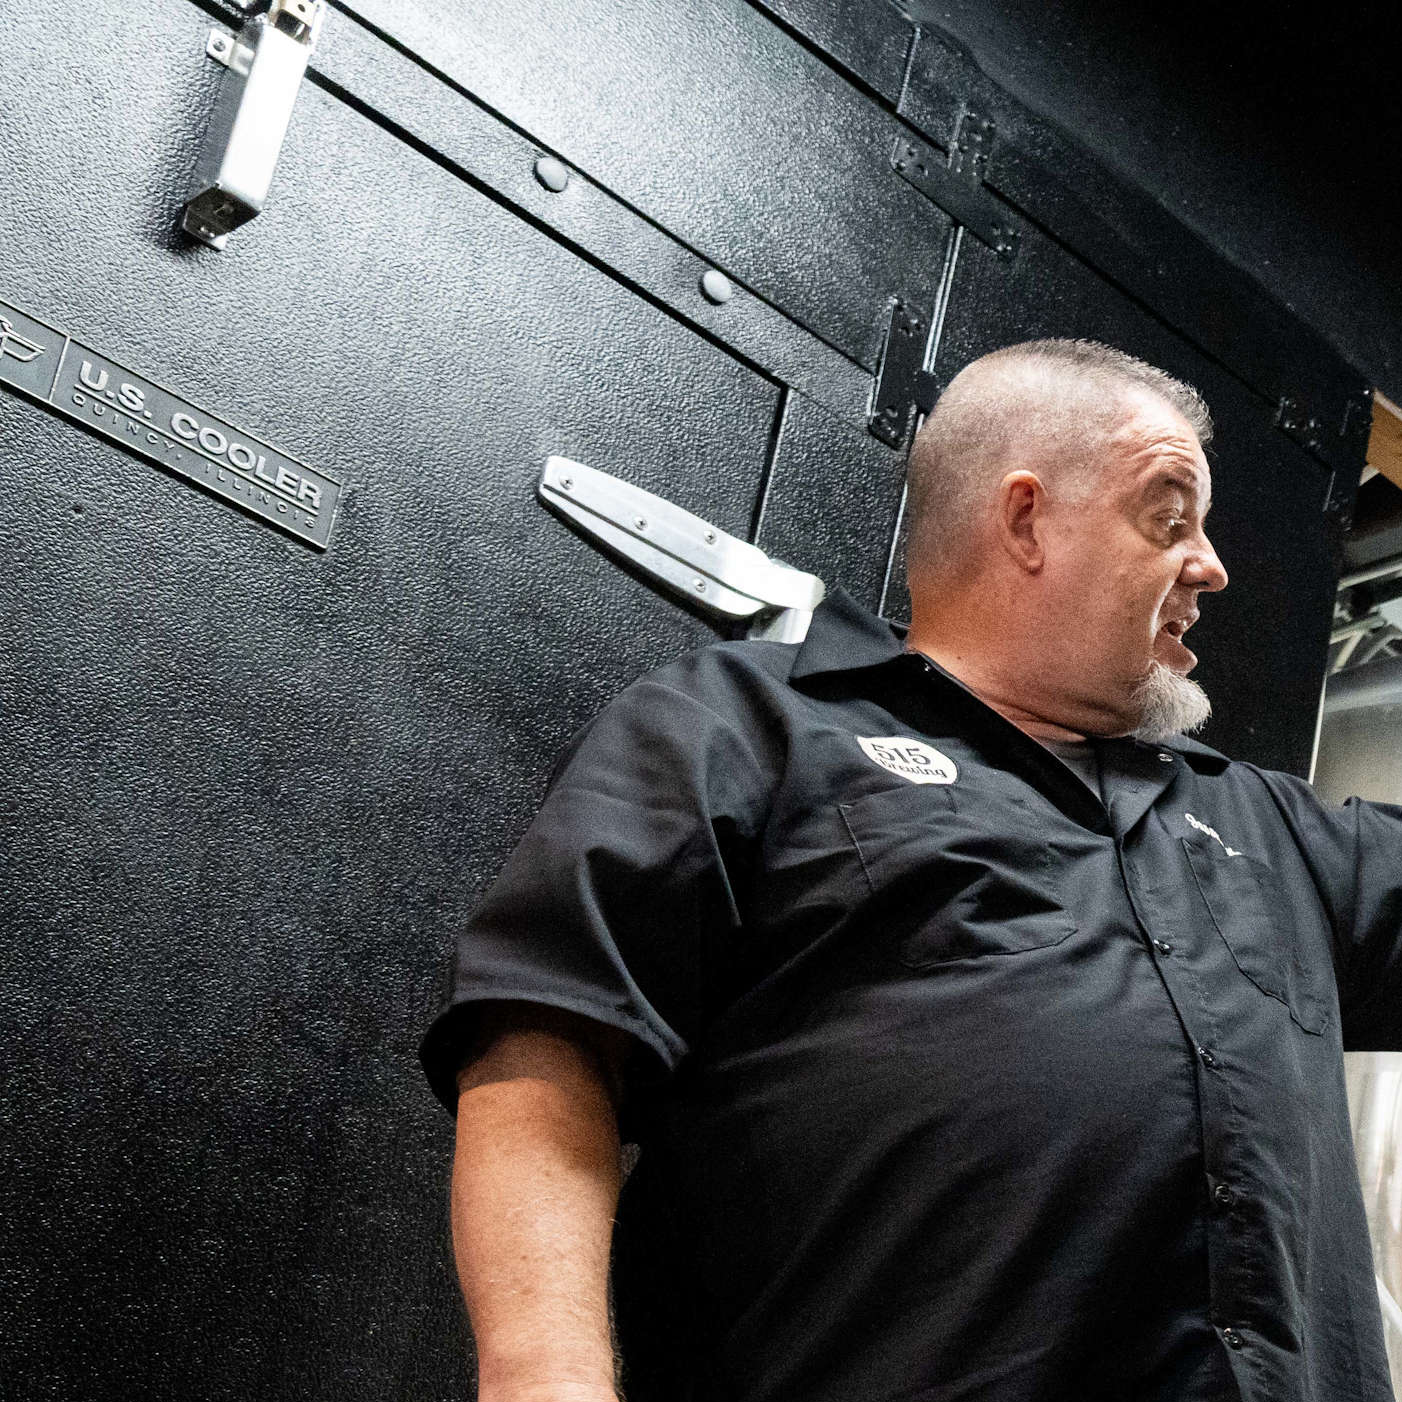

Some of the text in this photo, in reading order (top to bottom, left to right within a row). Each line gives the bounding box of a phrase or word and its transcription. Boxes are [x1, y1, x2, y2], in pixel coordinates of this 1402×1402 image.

[80, 360, 322, 508] U.S. COOLER
[204, 463, 315, 528] ILLINOIS
[870, 743, 931, 765] 515
